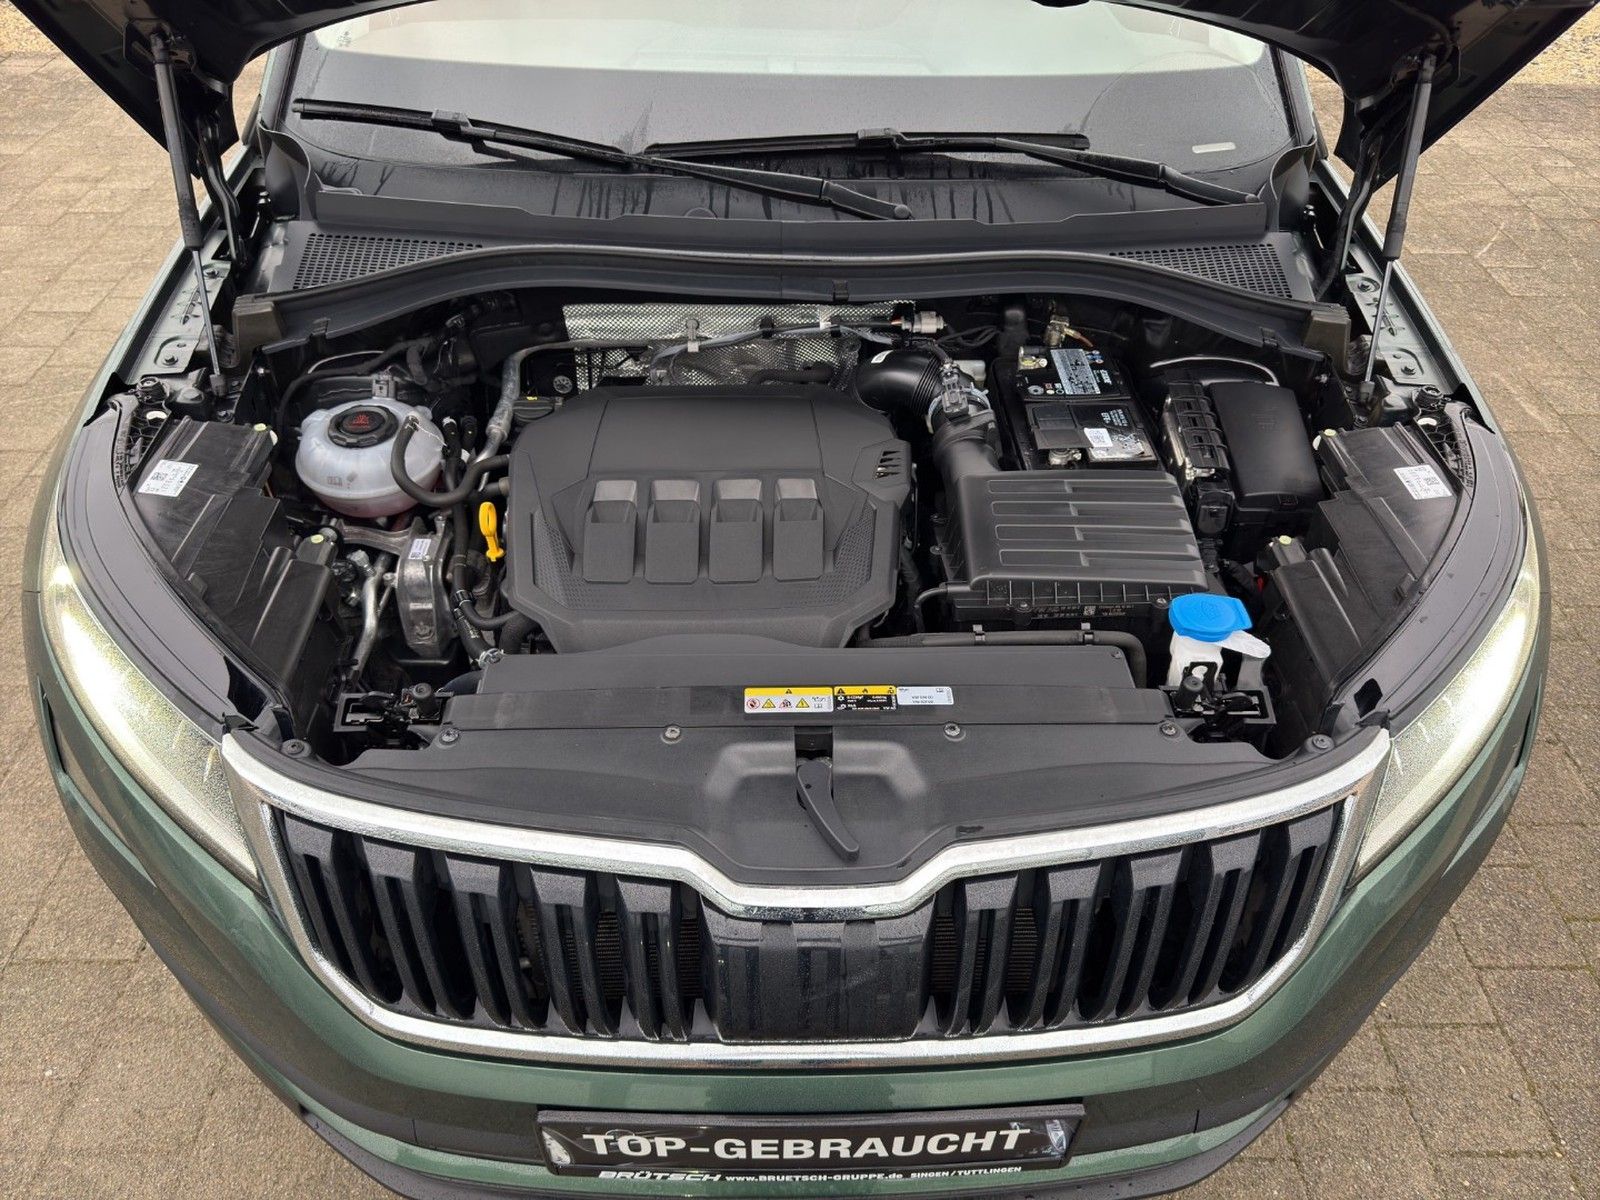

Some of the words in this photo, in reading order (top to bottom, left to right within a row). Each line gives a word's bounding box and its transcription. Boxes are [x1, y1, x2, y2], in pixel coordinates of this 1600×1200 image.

[583, 1129, 1031, 1159] TOP-GEBRAUCHT
[598, 1170, 722, 1182] BRÜTSCH
[726, 1173, 903, 1182] www.BRUETSCH-GRUPPE.de
